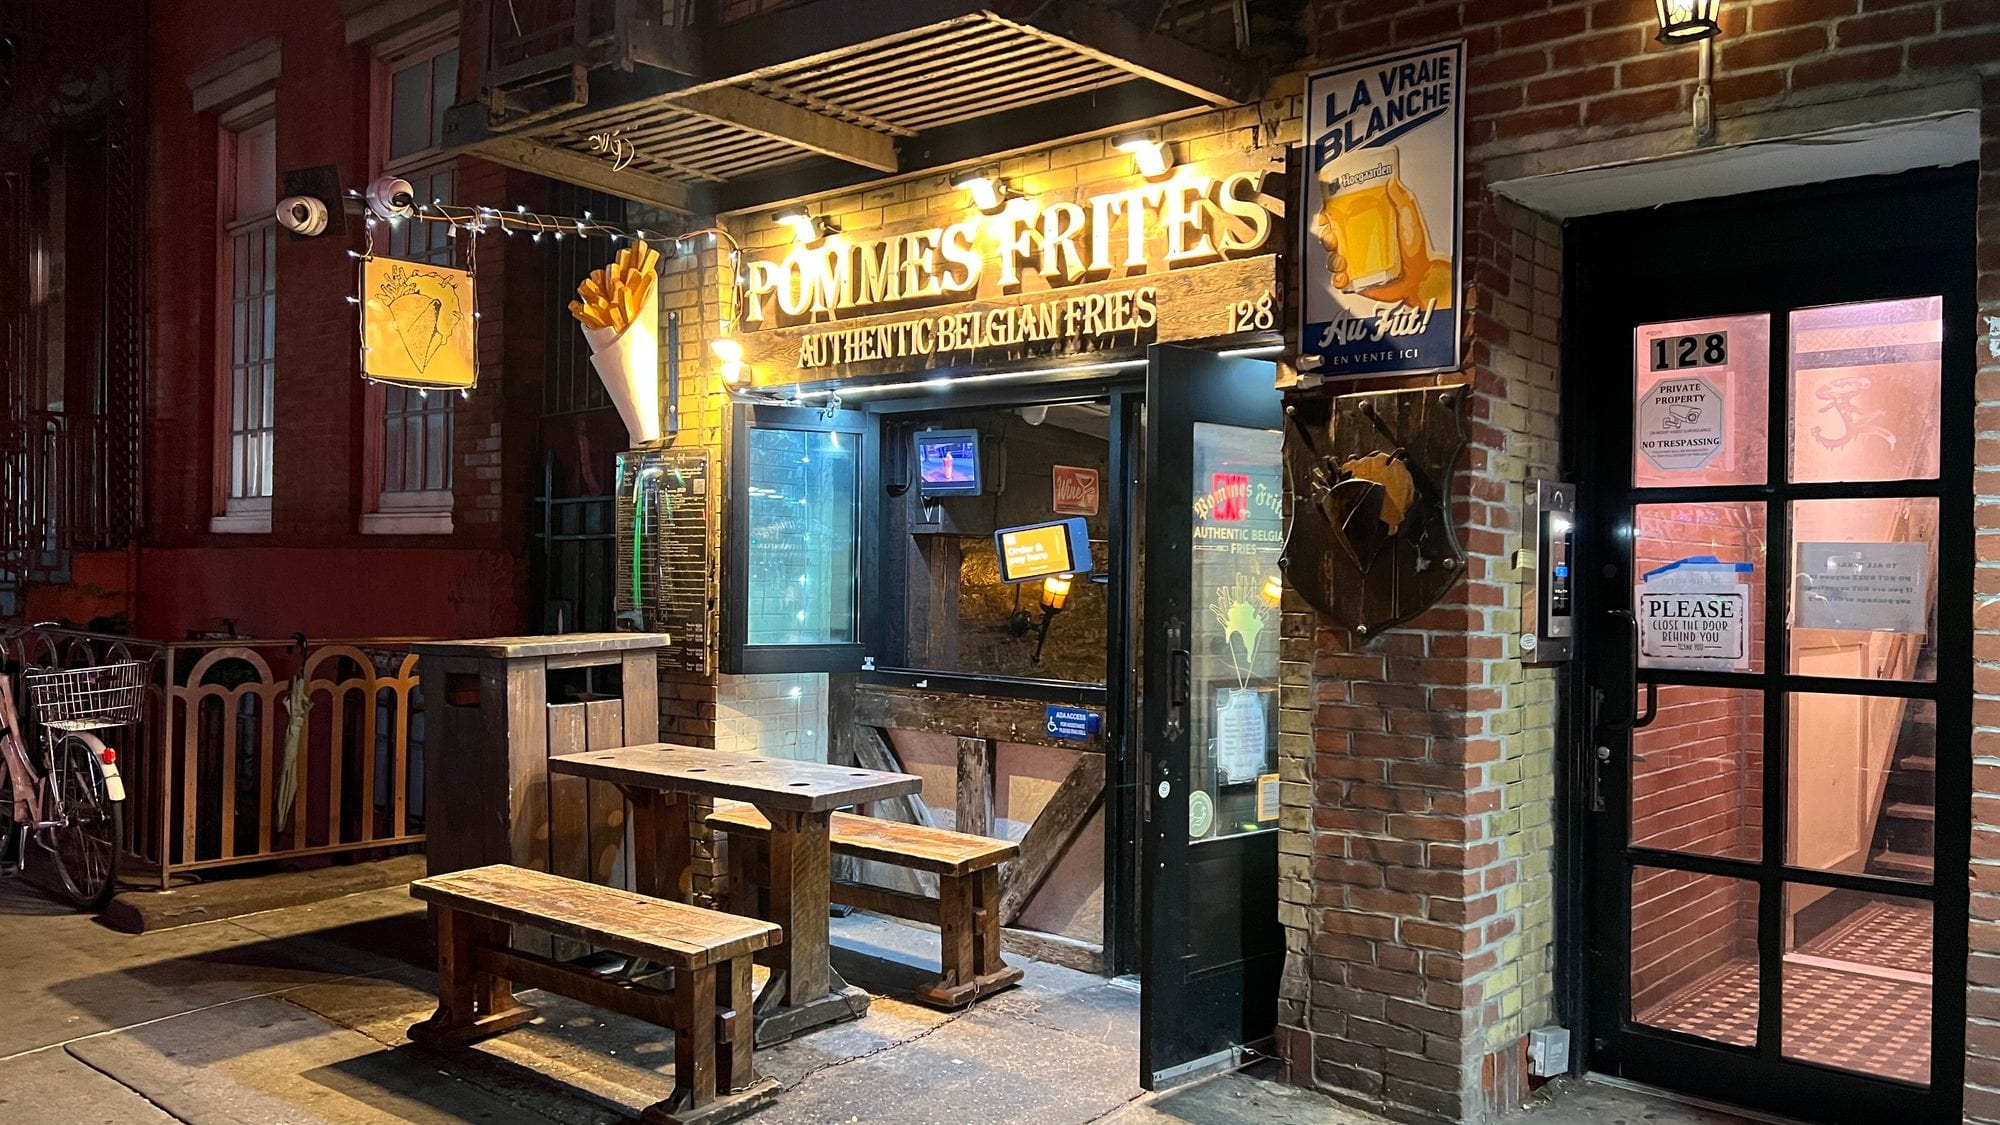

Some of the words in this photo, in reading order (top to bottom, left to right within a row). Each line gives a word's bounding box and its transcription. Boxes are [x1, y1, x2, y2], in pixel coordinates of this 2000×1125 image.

[1326, 80, 1371, 128] LA
[1378, 57, 1450, 97] VRAIE
[1315, 83, 1450, 172] BLANCHE
[1342, 163, 1392, 187] Hoegaarden
[744, 221, 984, 321] POMMES
[998, 170, 1272, 286] FRITES
[1225, 290, 1275, 334] 128
[796, 317, 936, 369] AUTHENTIC
[936, 301, 1059, 353] BELGIAN
[1064, 286, 1157, 338] FRIES
[1318, 307, 1368, 348] Au
[1333, 355, 1349, 366] EN
[1354, 351, 1393, 363] VENTE
[1399, 348, 1418, 359] ICI
[1656, 334, 1725, 369] 128
[1660, 384, 1701, 394] PRIVATE
[1655, 394, 1706, 405] PROPERTY
[1657, 438, 1720, 447] TRESPASSING
[1056, 475, 1085, 500] Wine
[1193, 483, 1253, 520] Pommes
[1193, 526, 1249, 540] AUTHENTIC
[1008, 544, 1034, 555] Order
[1026, 552, 1048, 561] here
[1231, 543, 1257, 555] FRIES
[1649, 600, 1734, 618] PLEASE
[1652, 620, 1678, 631] CLOSE
[1682, 620, 1698, 631] THE
[1702, 620, 1728, 631] DOOR
[1662, 631, 1696, 642] BEHIND
[1700, 632, 1719, 642] YOU
